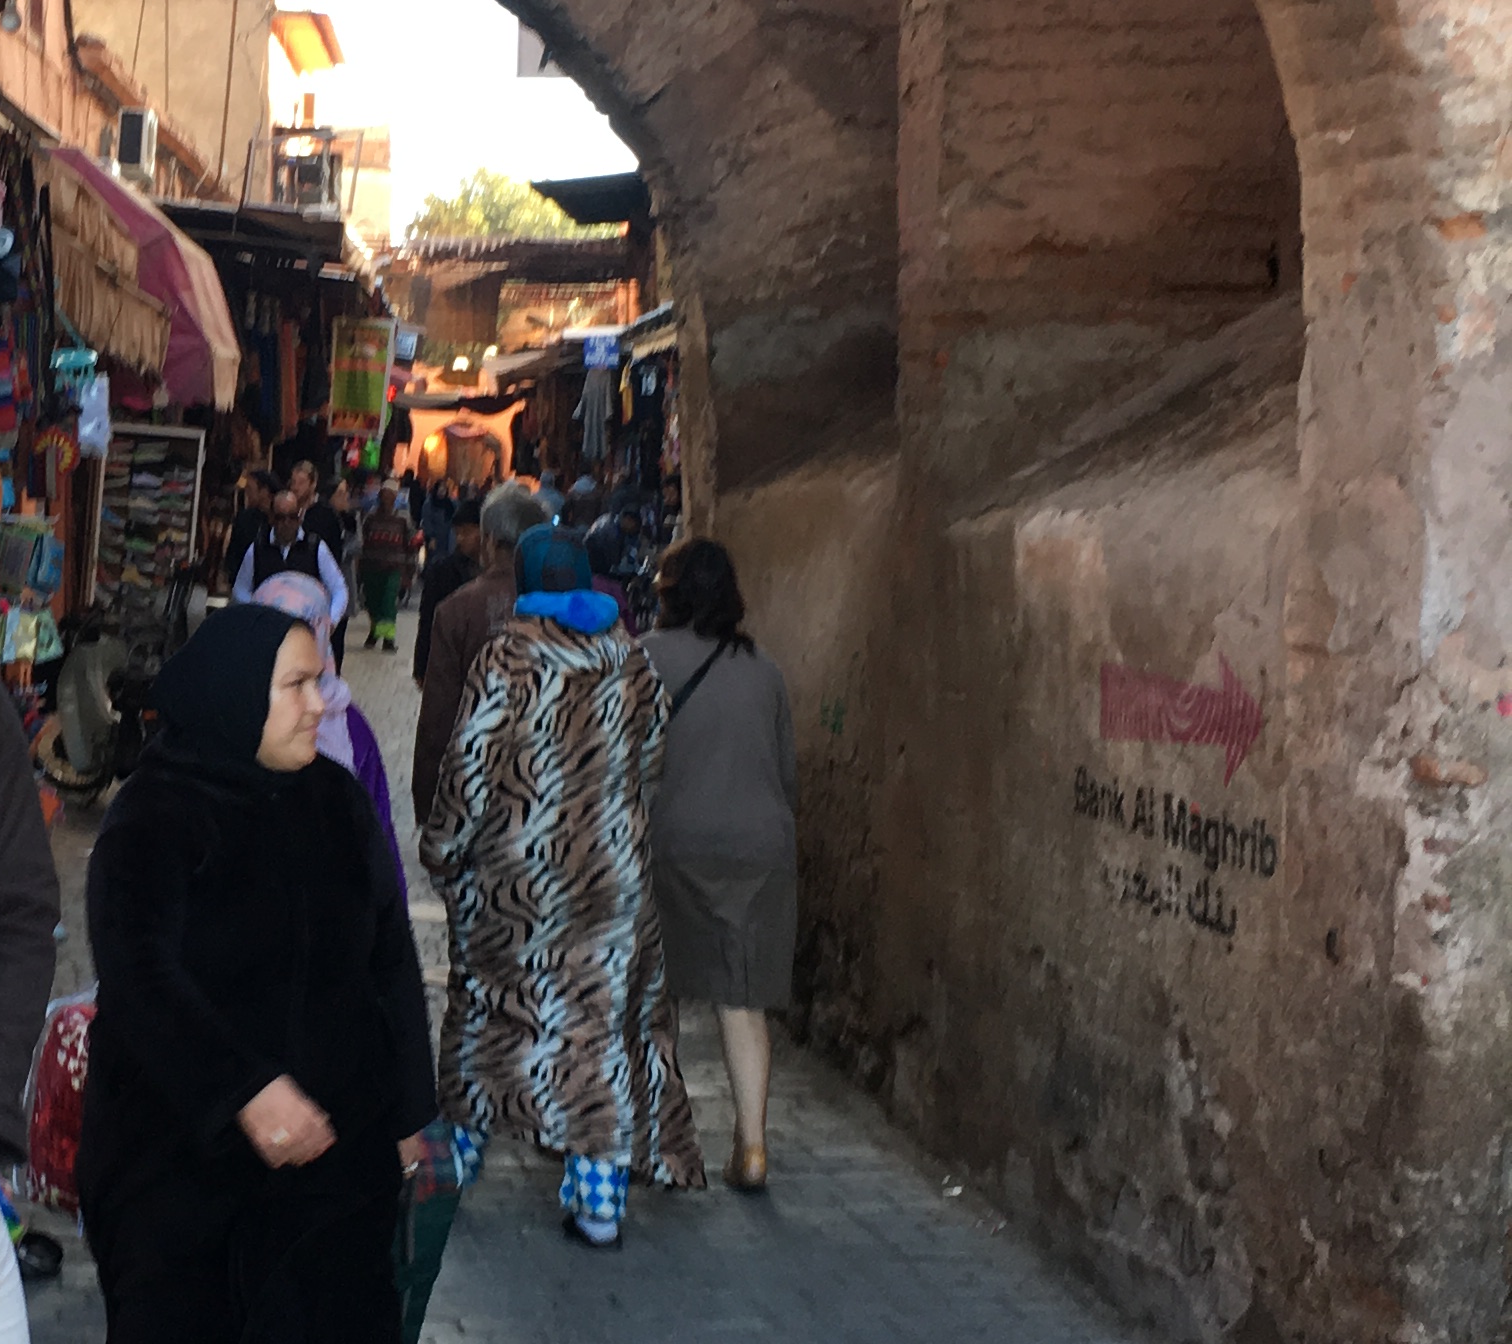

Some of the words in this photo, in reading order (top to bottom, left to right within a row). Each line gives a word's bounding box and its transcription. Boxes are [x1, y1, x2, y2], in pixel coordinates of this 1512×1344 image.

[1073, 764, 1126, 829] Bank
[1130, 786, 1156, 840] Al
[1162, 791, 1278, 878] Maghrib
